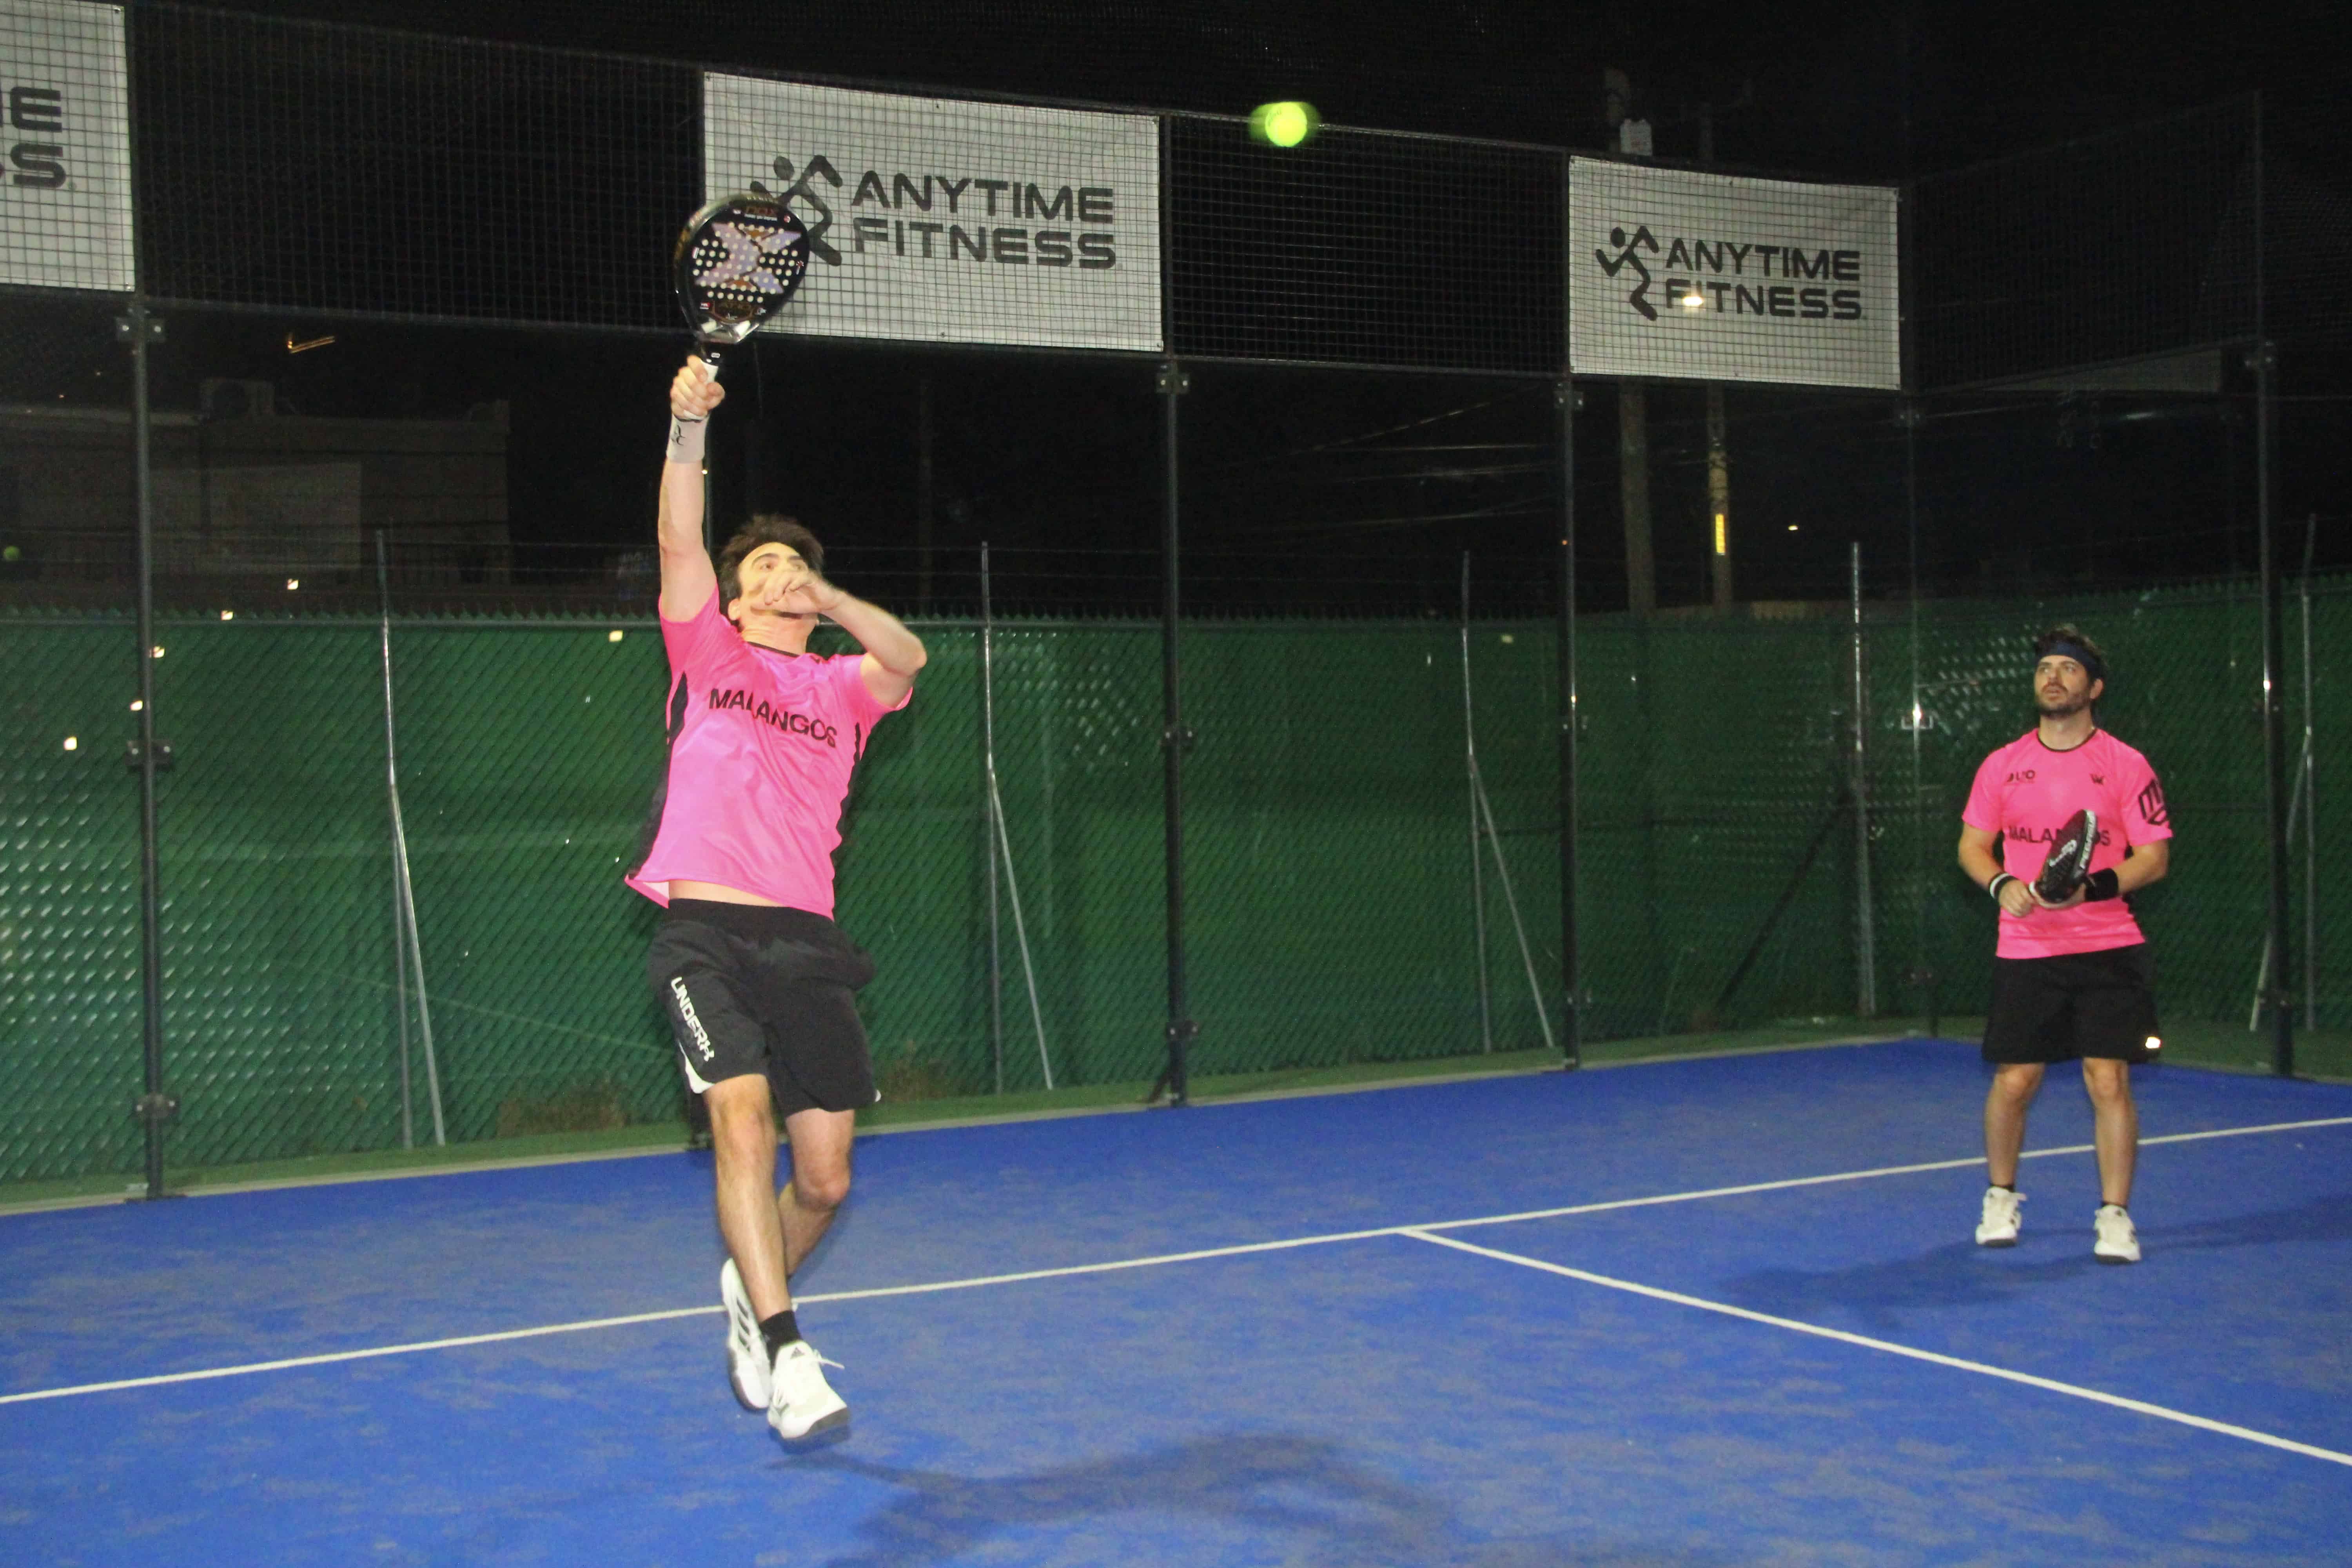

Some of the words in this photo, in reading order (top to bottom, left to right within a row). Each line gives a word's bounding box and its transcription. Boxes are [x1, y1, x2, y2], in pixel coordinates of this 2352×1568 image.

[852, 171, 1114, 223] ANYTIME
[855, 218, 1116, 269] FITNESS
[1666, 238, 1860, 281] ANYTIME
[1666, 278, 1862, 320] FITNESS
[708, 688, 837, 748] MALANGOS
